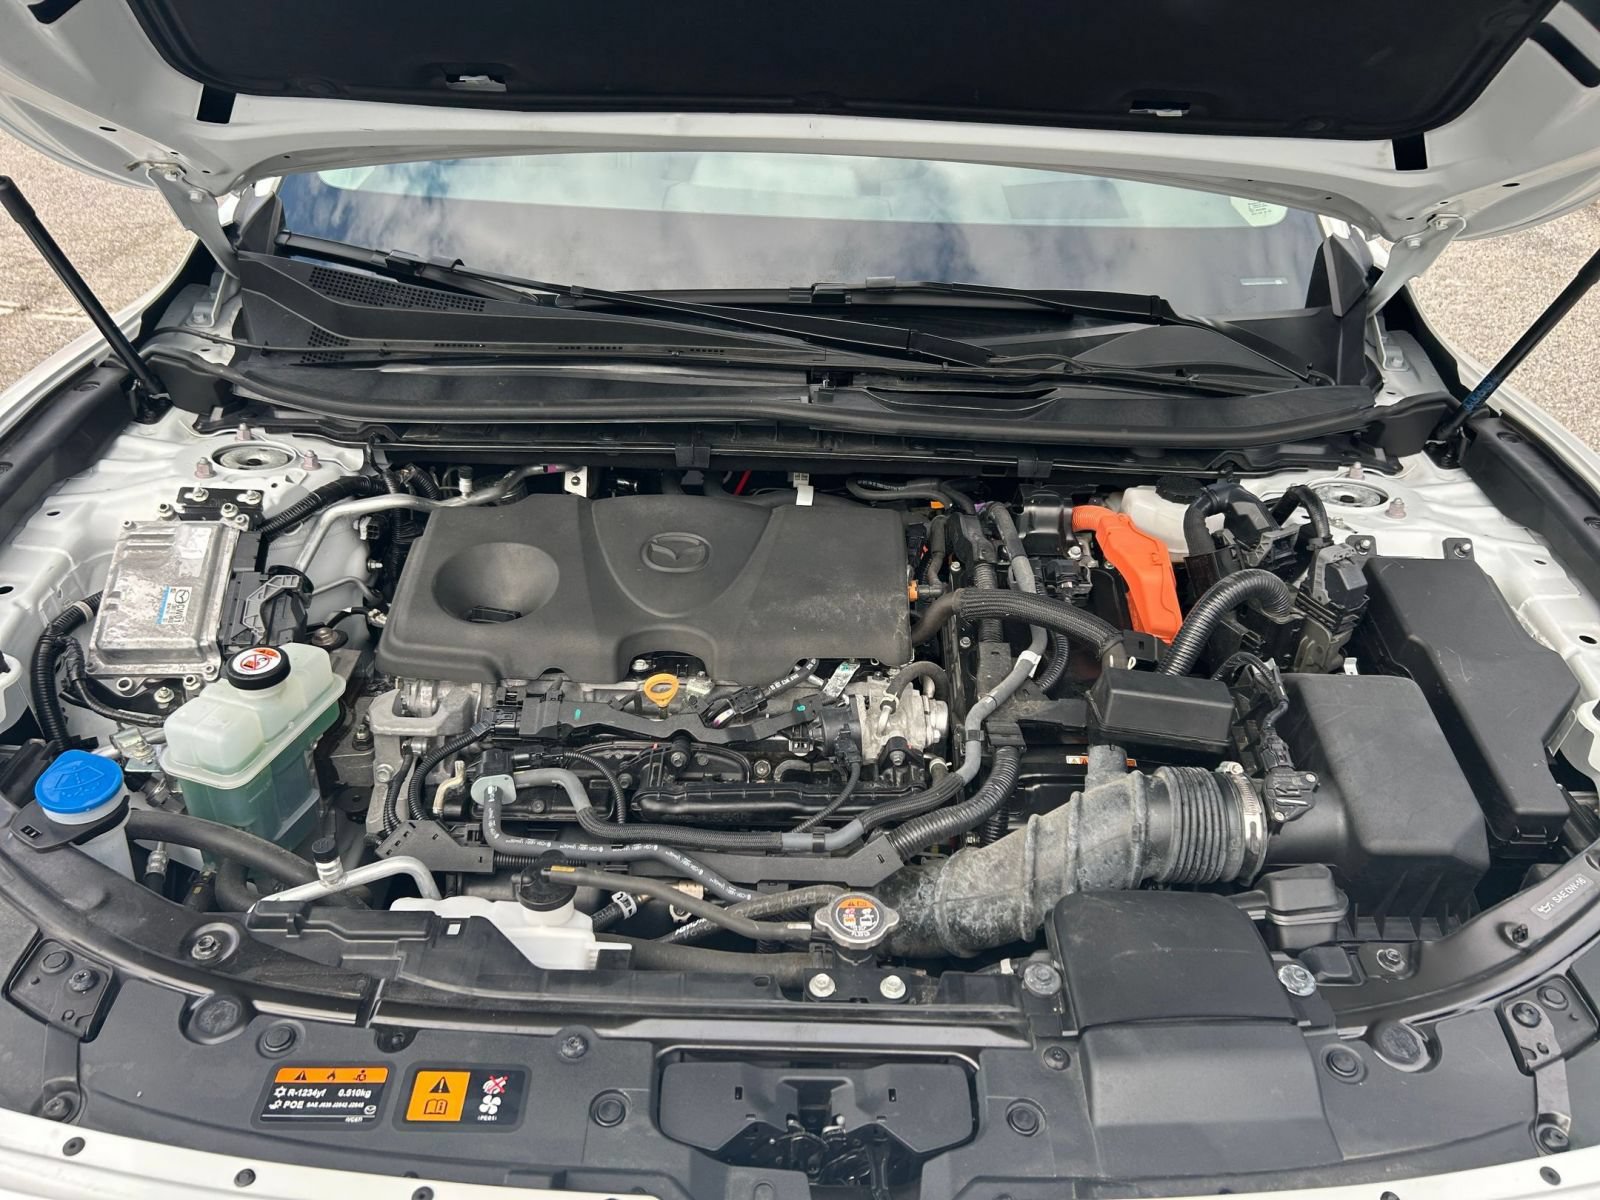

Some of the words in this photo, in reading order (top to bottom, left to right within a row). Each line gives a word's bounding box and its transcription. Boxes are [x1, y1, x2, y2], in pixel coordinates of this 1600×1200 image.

[1552, 890, 1569, 903] SAE
[287, 1088, 327, 1099] R-1234yf
[338, 1088, 372, 1098] 0.510kg
[283, 1100, 305, 1109] POE
